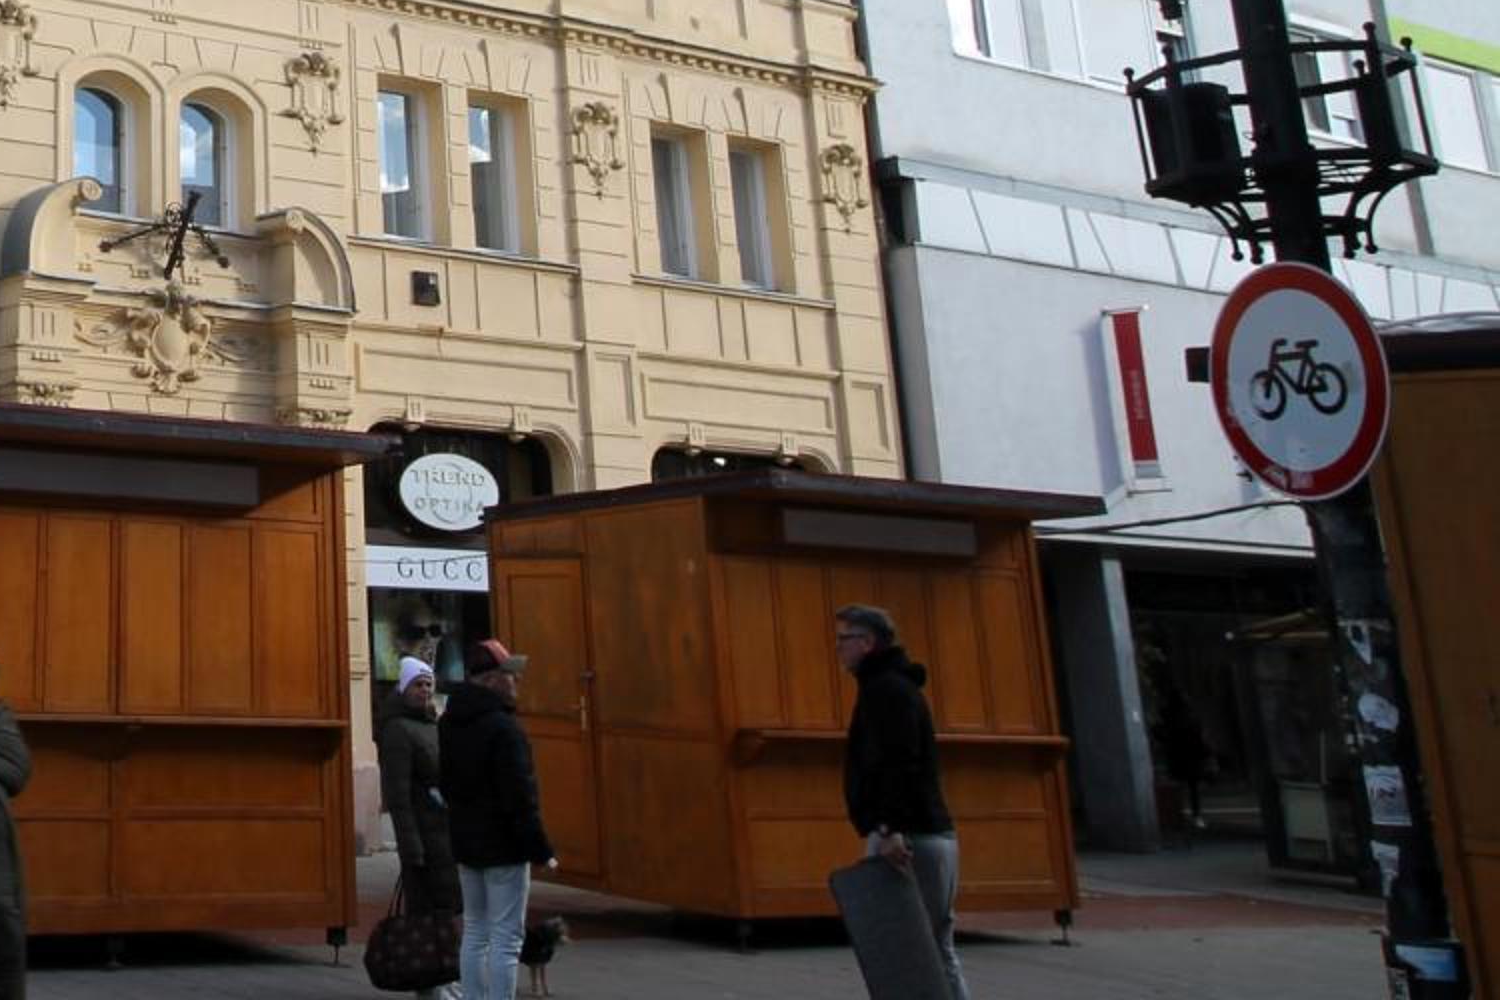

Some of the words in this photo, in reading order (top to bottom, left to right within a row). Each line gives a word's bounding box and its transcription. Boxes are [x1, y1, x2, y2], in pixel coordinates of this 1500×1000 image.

[410, 468, 485, 487] TREND
[414, 497, 485, 513] OPTIKA
[397, 558, 483, 582] GUCC
